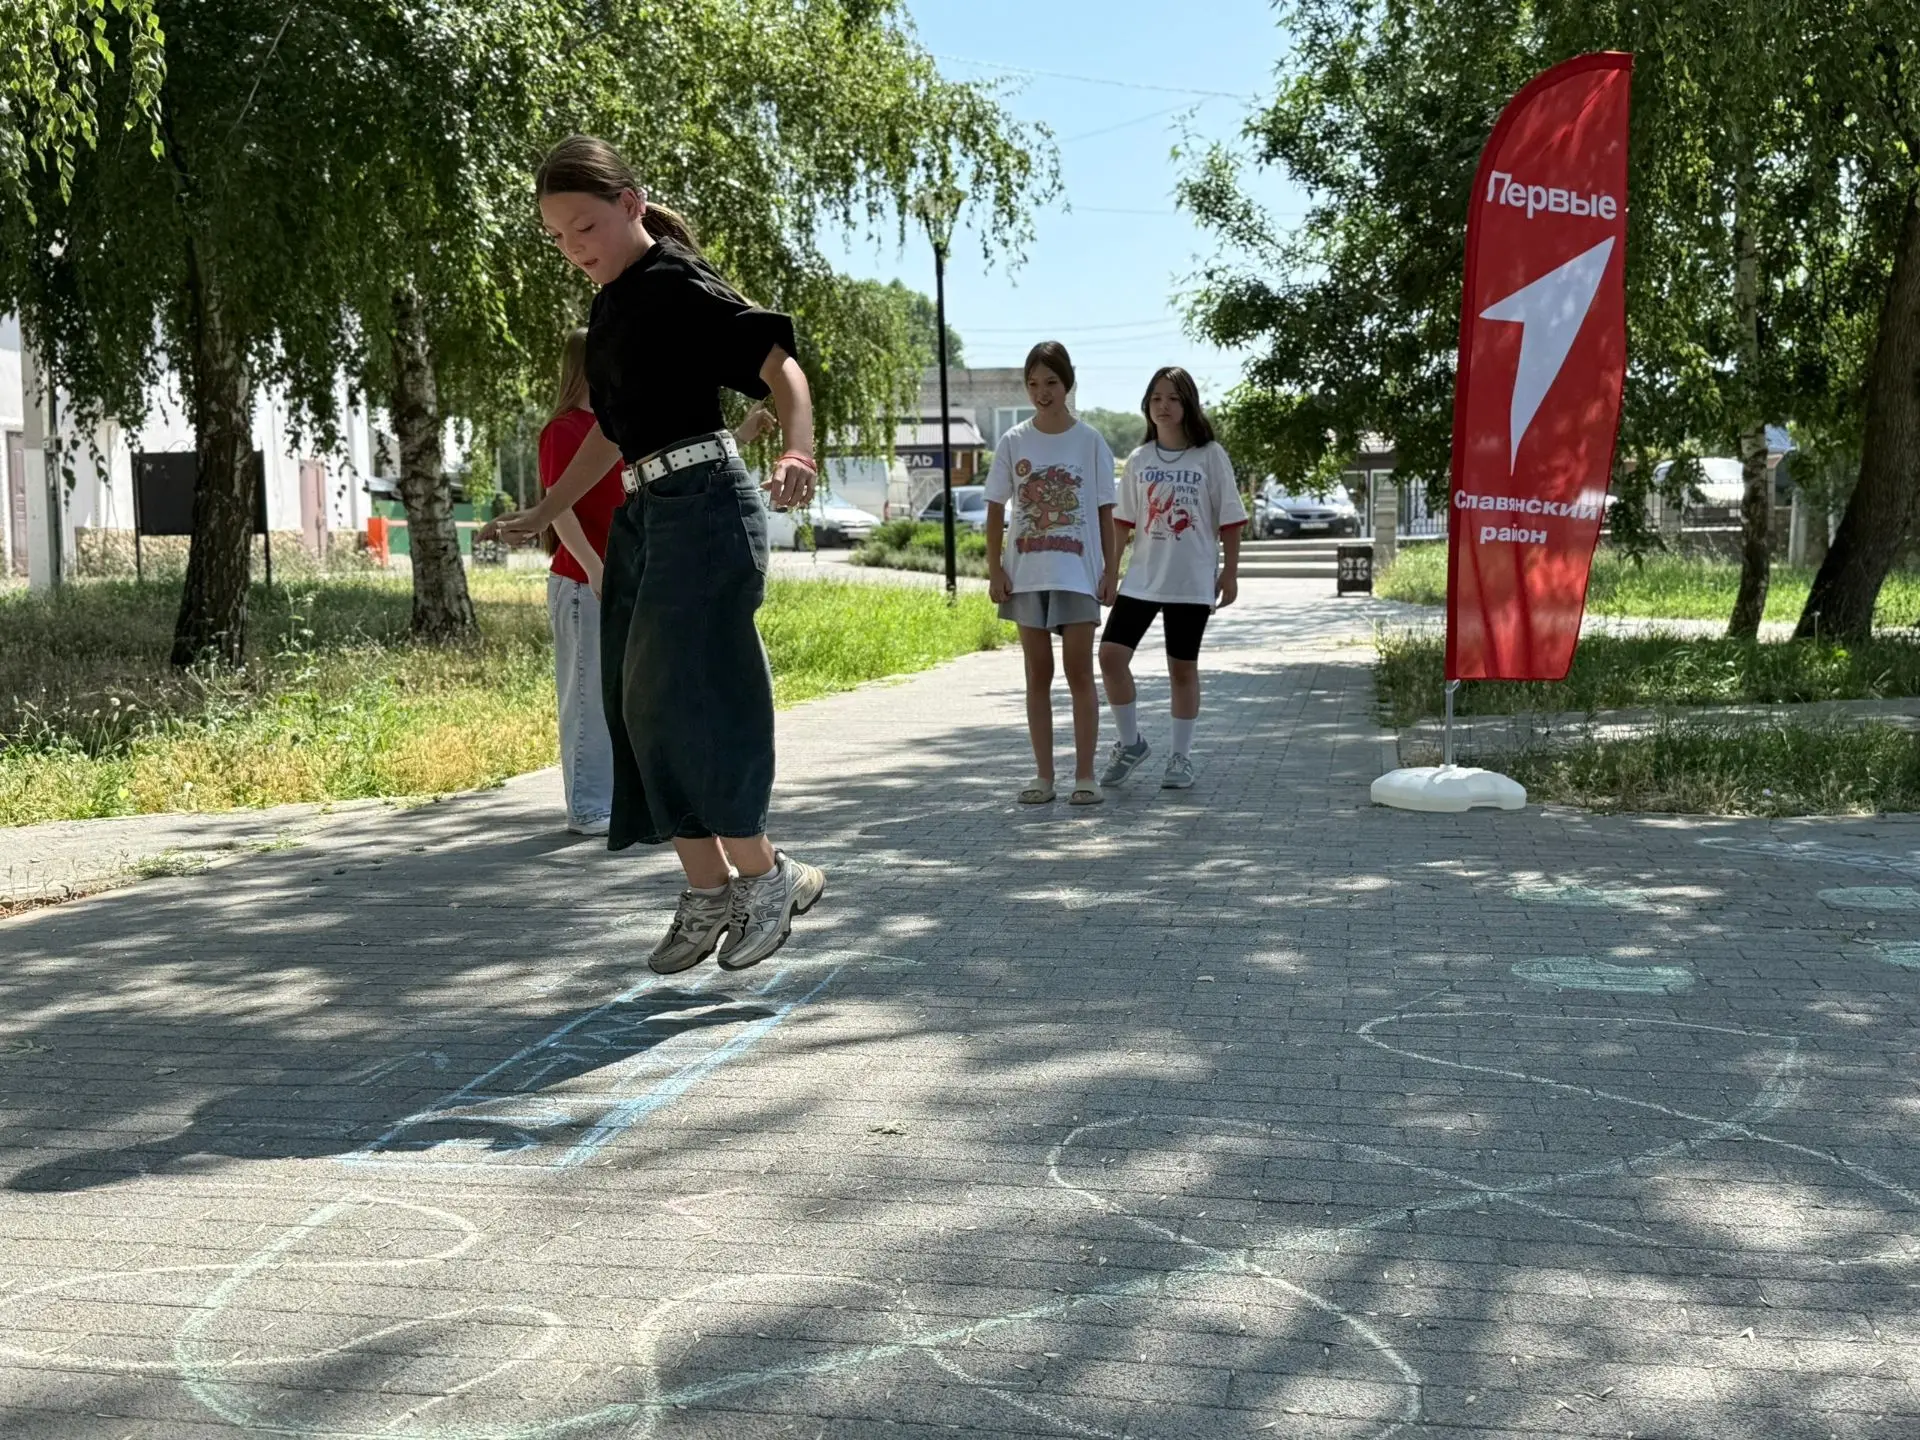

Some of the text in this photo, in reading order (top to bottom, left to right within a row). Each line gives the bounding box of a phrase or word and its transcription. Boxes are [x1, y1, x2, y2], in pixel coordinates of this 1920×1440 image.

[1486, 169, 1617, 220] Первые
[1138, 470, 1202, 485] LOBSTER
[1454, 489, 1598, 521] Славянский
[1480, 523, 1548, 545] район
